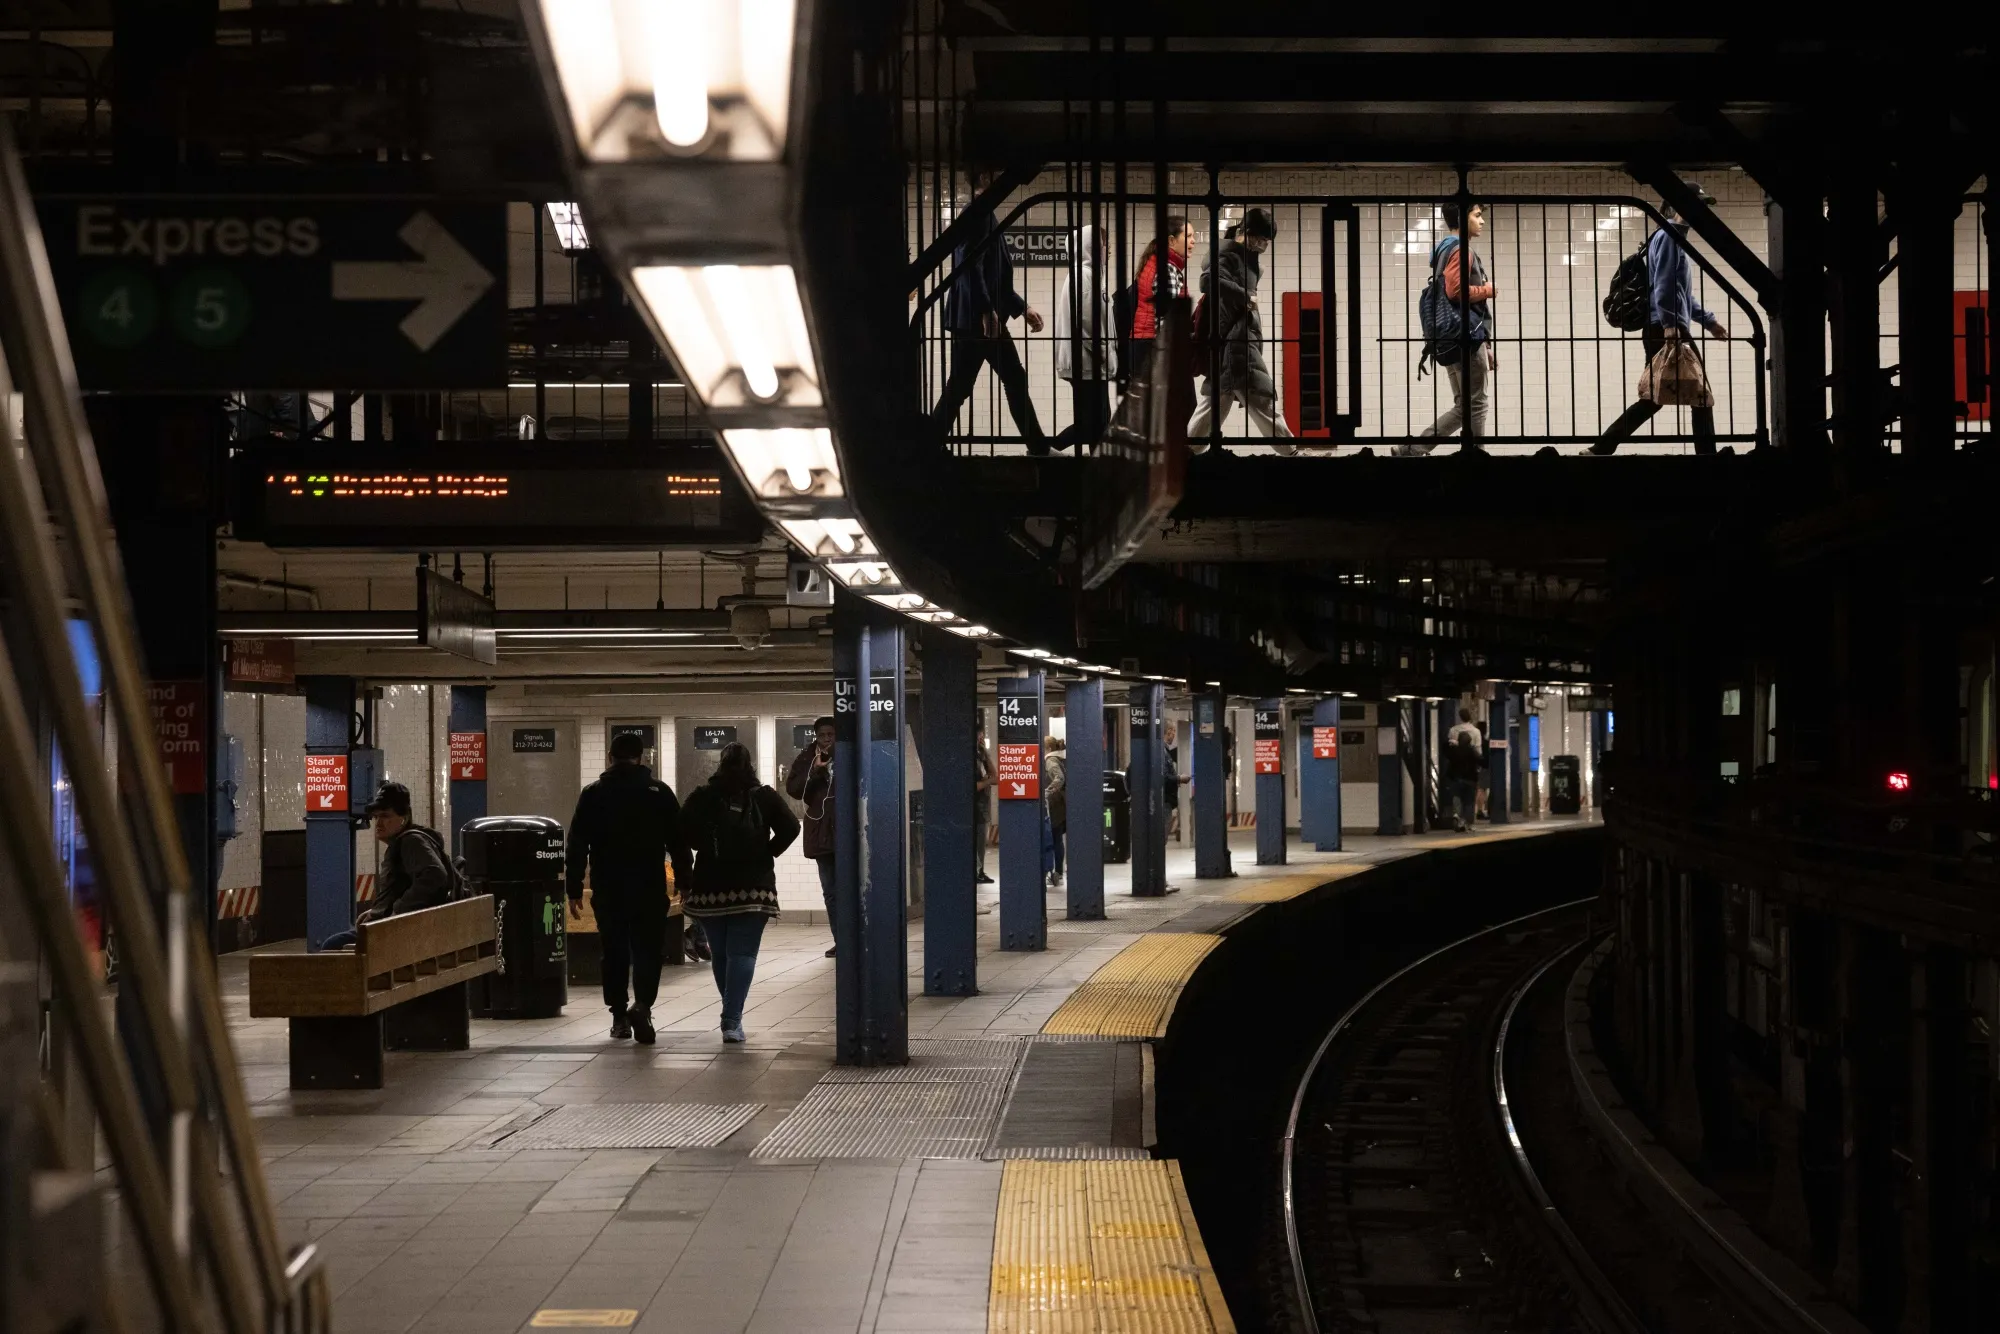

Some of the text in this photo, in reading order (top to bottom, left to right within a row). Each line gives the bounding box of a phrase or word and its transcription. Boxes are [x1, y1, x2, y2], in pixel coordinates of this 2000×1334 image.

[77, 205, 319, 266] Express
[1005, 234, 1066, 250] POLICE
[1029, 252, 1059, 261] Transt
[99, 285, 228, 331] 4 5
[835, 681, 881, 696] Unn
[175, 702, 195, 718] of
[999, 698, 1020, 715] 14
[999, 715, 1038, 727] Street
[1255, 712, 1268, 723] 14
[1255, 722, 1279, 730] Street
[451, 734, 475, 742] Stand
[523, 733, 544, 742] Signals
[451, 741, 482, 749] clear of
[451, 749, 480, 758] moving
[999, 746, 1027, 755] Stand
[307, 757, 335, 766] Stand
[451, 757, 484, 765] platform
[999, 755, 1036, 763] clear of
[307, 765, 344, 774] clear of
[999, 763, 1033, 772] moving
[307, 775, 341, 784] moving
[999, 771, 1038, 781] platform
[307, 784, 346, 793] platform
[535, 850, 559, 860] Stops
